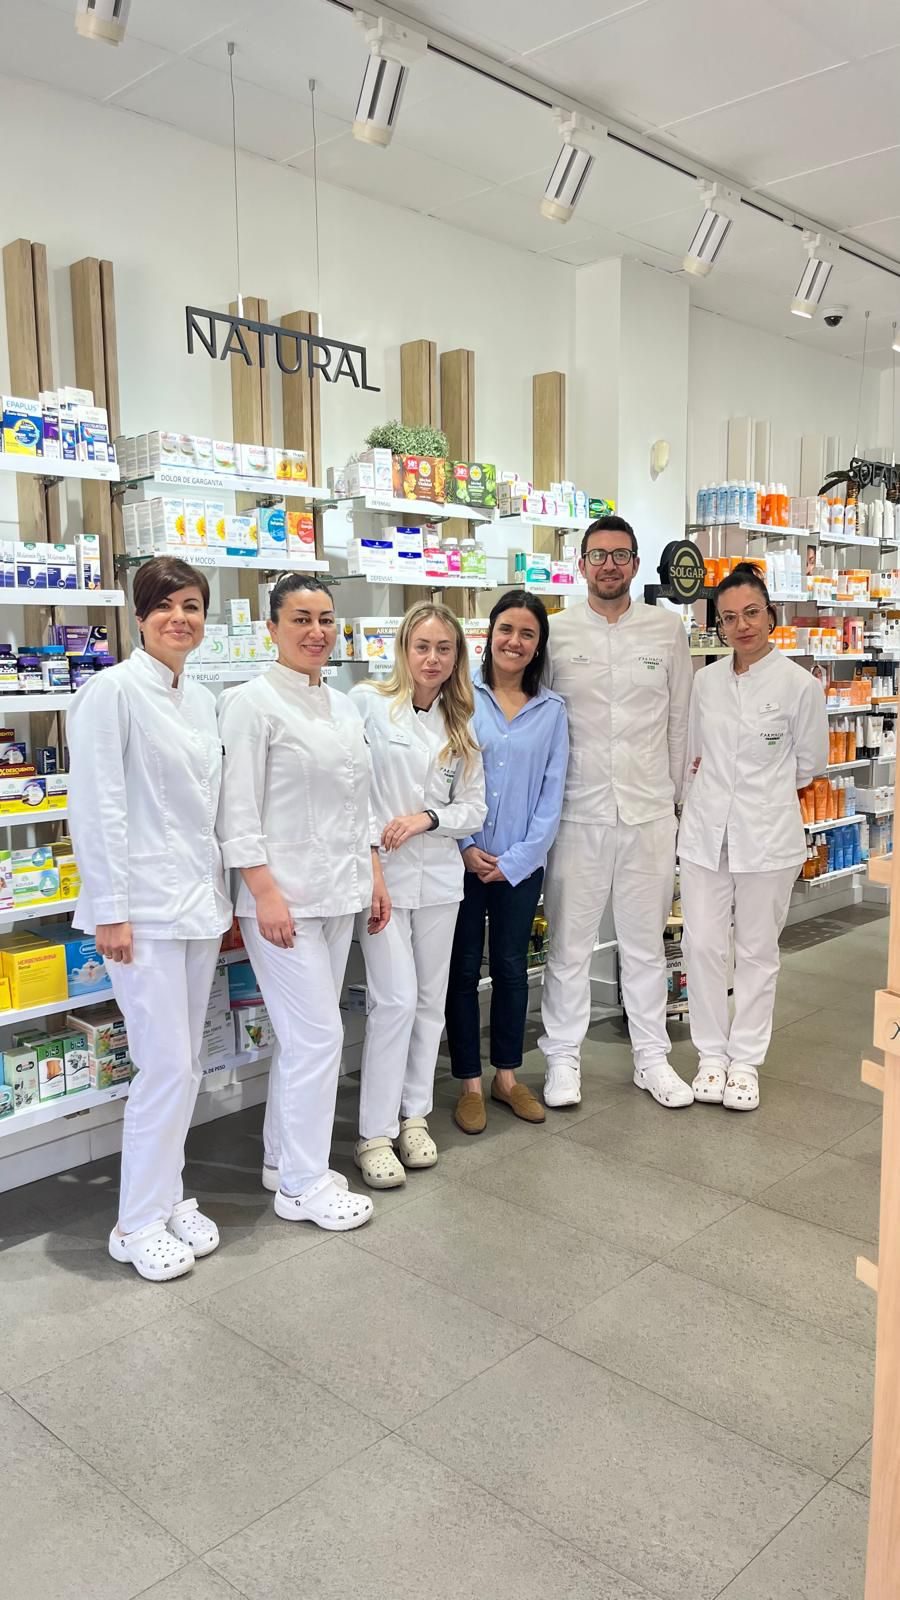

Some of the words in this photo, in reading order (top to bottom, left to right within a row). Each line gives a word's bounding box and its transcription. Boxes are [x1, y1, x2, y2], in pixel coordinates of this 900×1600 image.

[186, 306, 381, 392] NATURAL
[6, 400, 38, 412] EPAPLUS
[160, 474, 182, 483] DOLOR
[182, 476, 191, 484] DE
[191, 477, 224, 487] GARGANTA
[195, 557, 216, 565] MOCOS
[670, 566, 704, 579] SOLGAR
[214, 1064, 226, 1073] PESO
